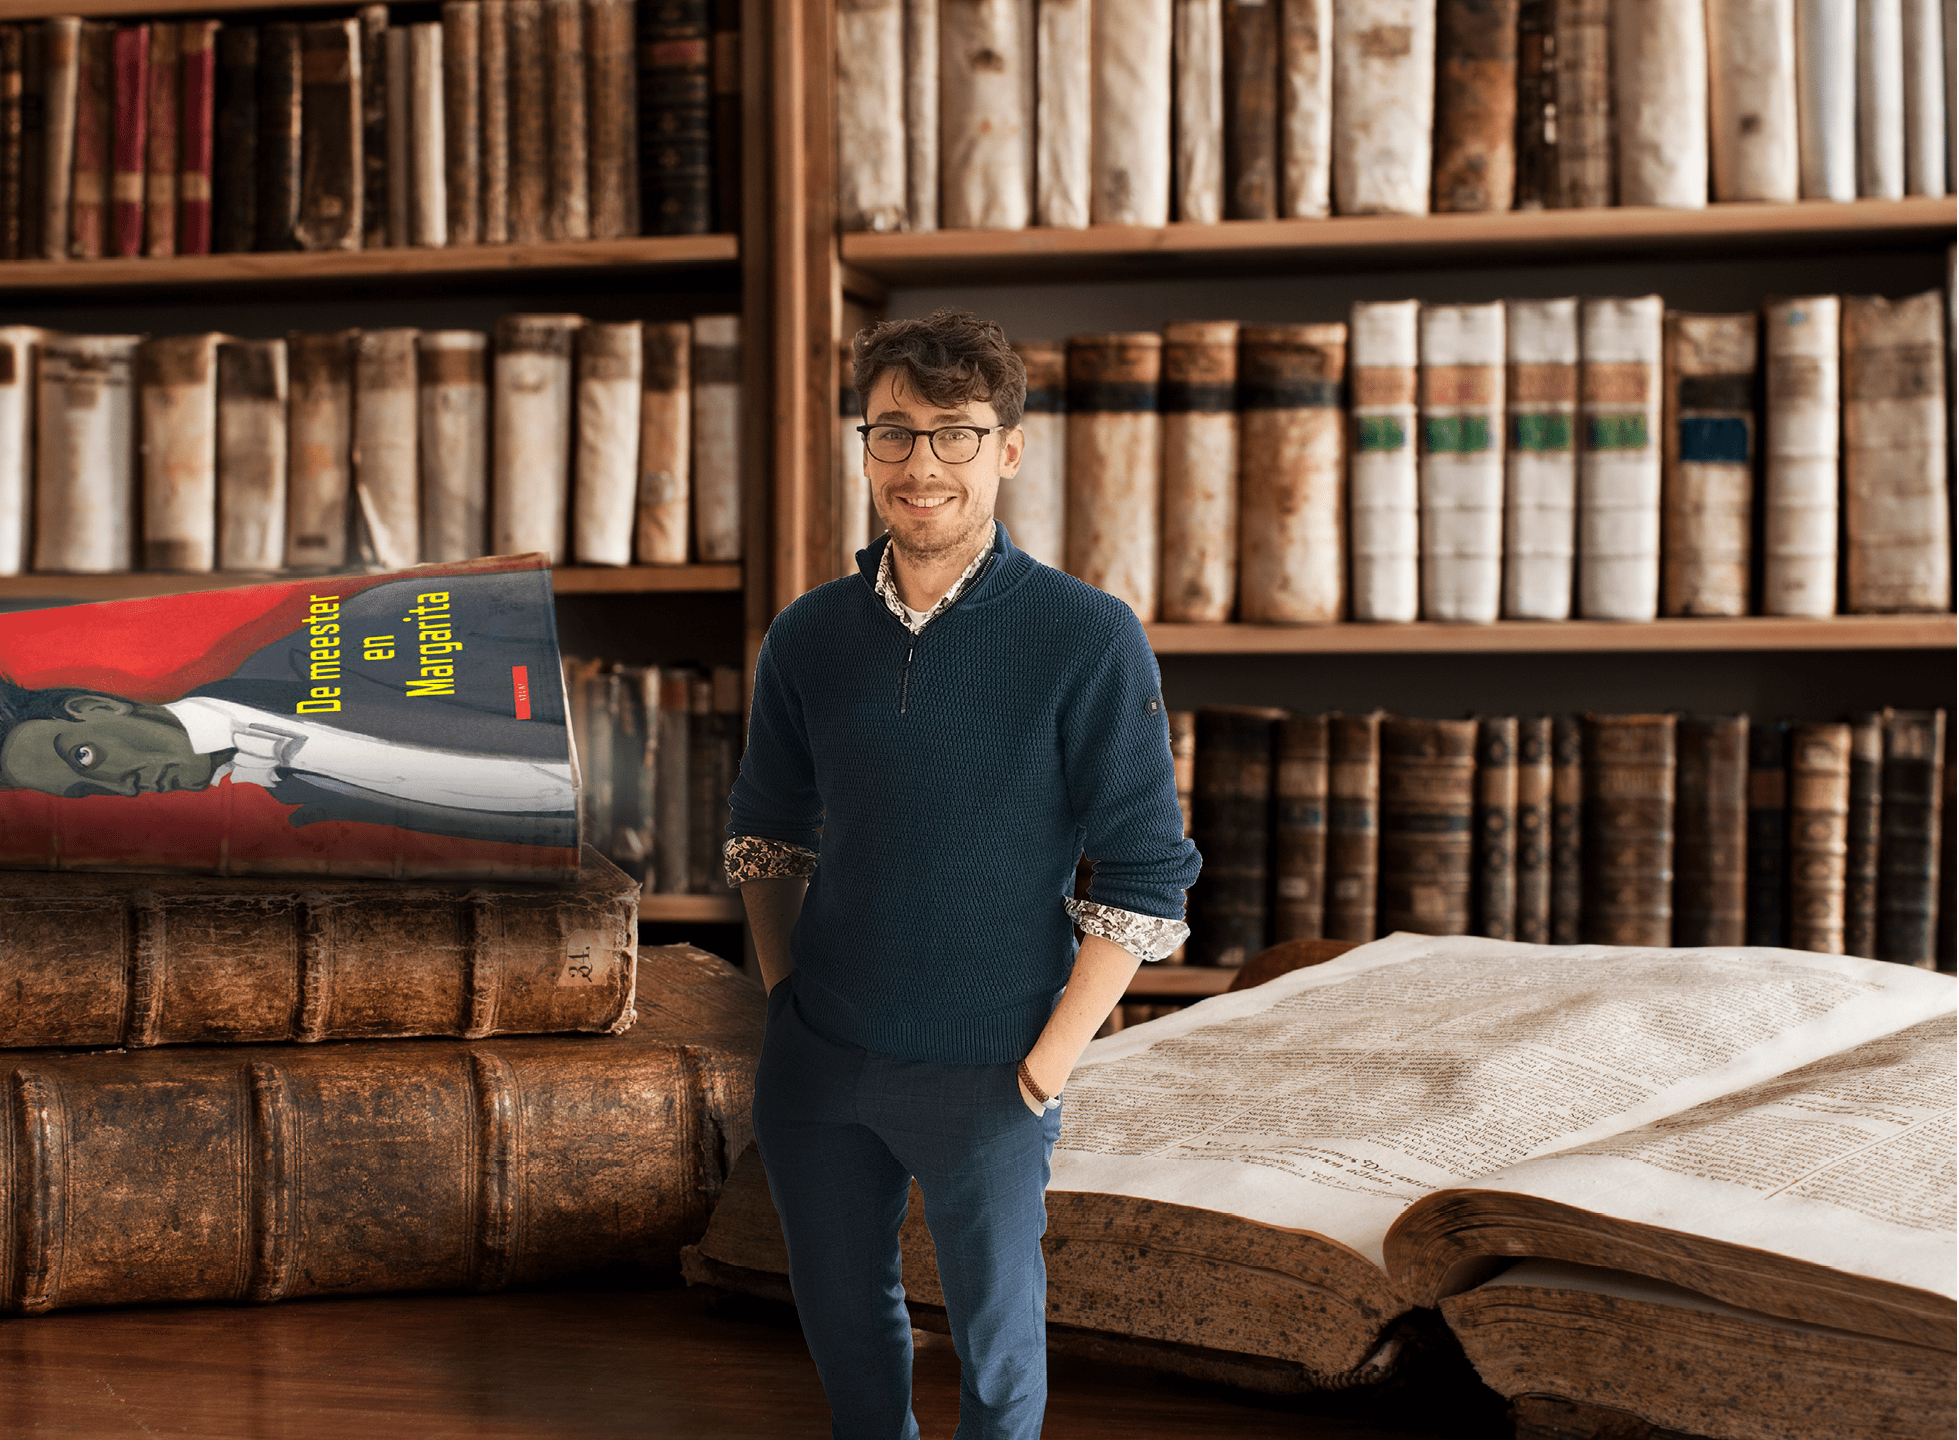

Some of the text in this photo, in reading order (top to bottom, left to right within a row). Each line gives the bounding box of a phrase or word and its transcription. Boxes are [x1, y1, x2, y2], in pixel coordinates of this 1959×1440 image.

[297, 595, 342, 714] De meester
[363, 635, 395, 661] en
[402, 591, 463, 697] Margarita
